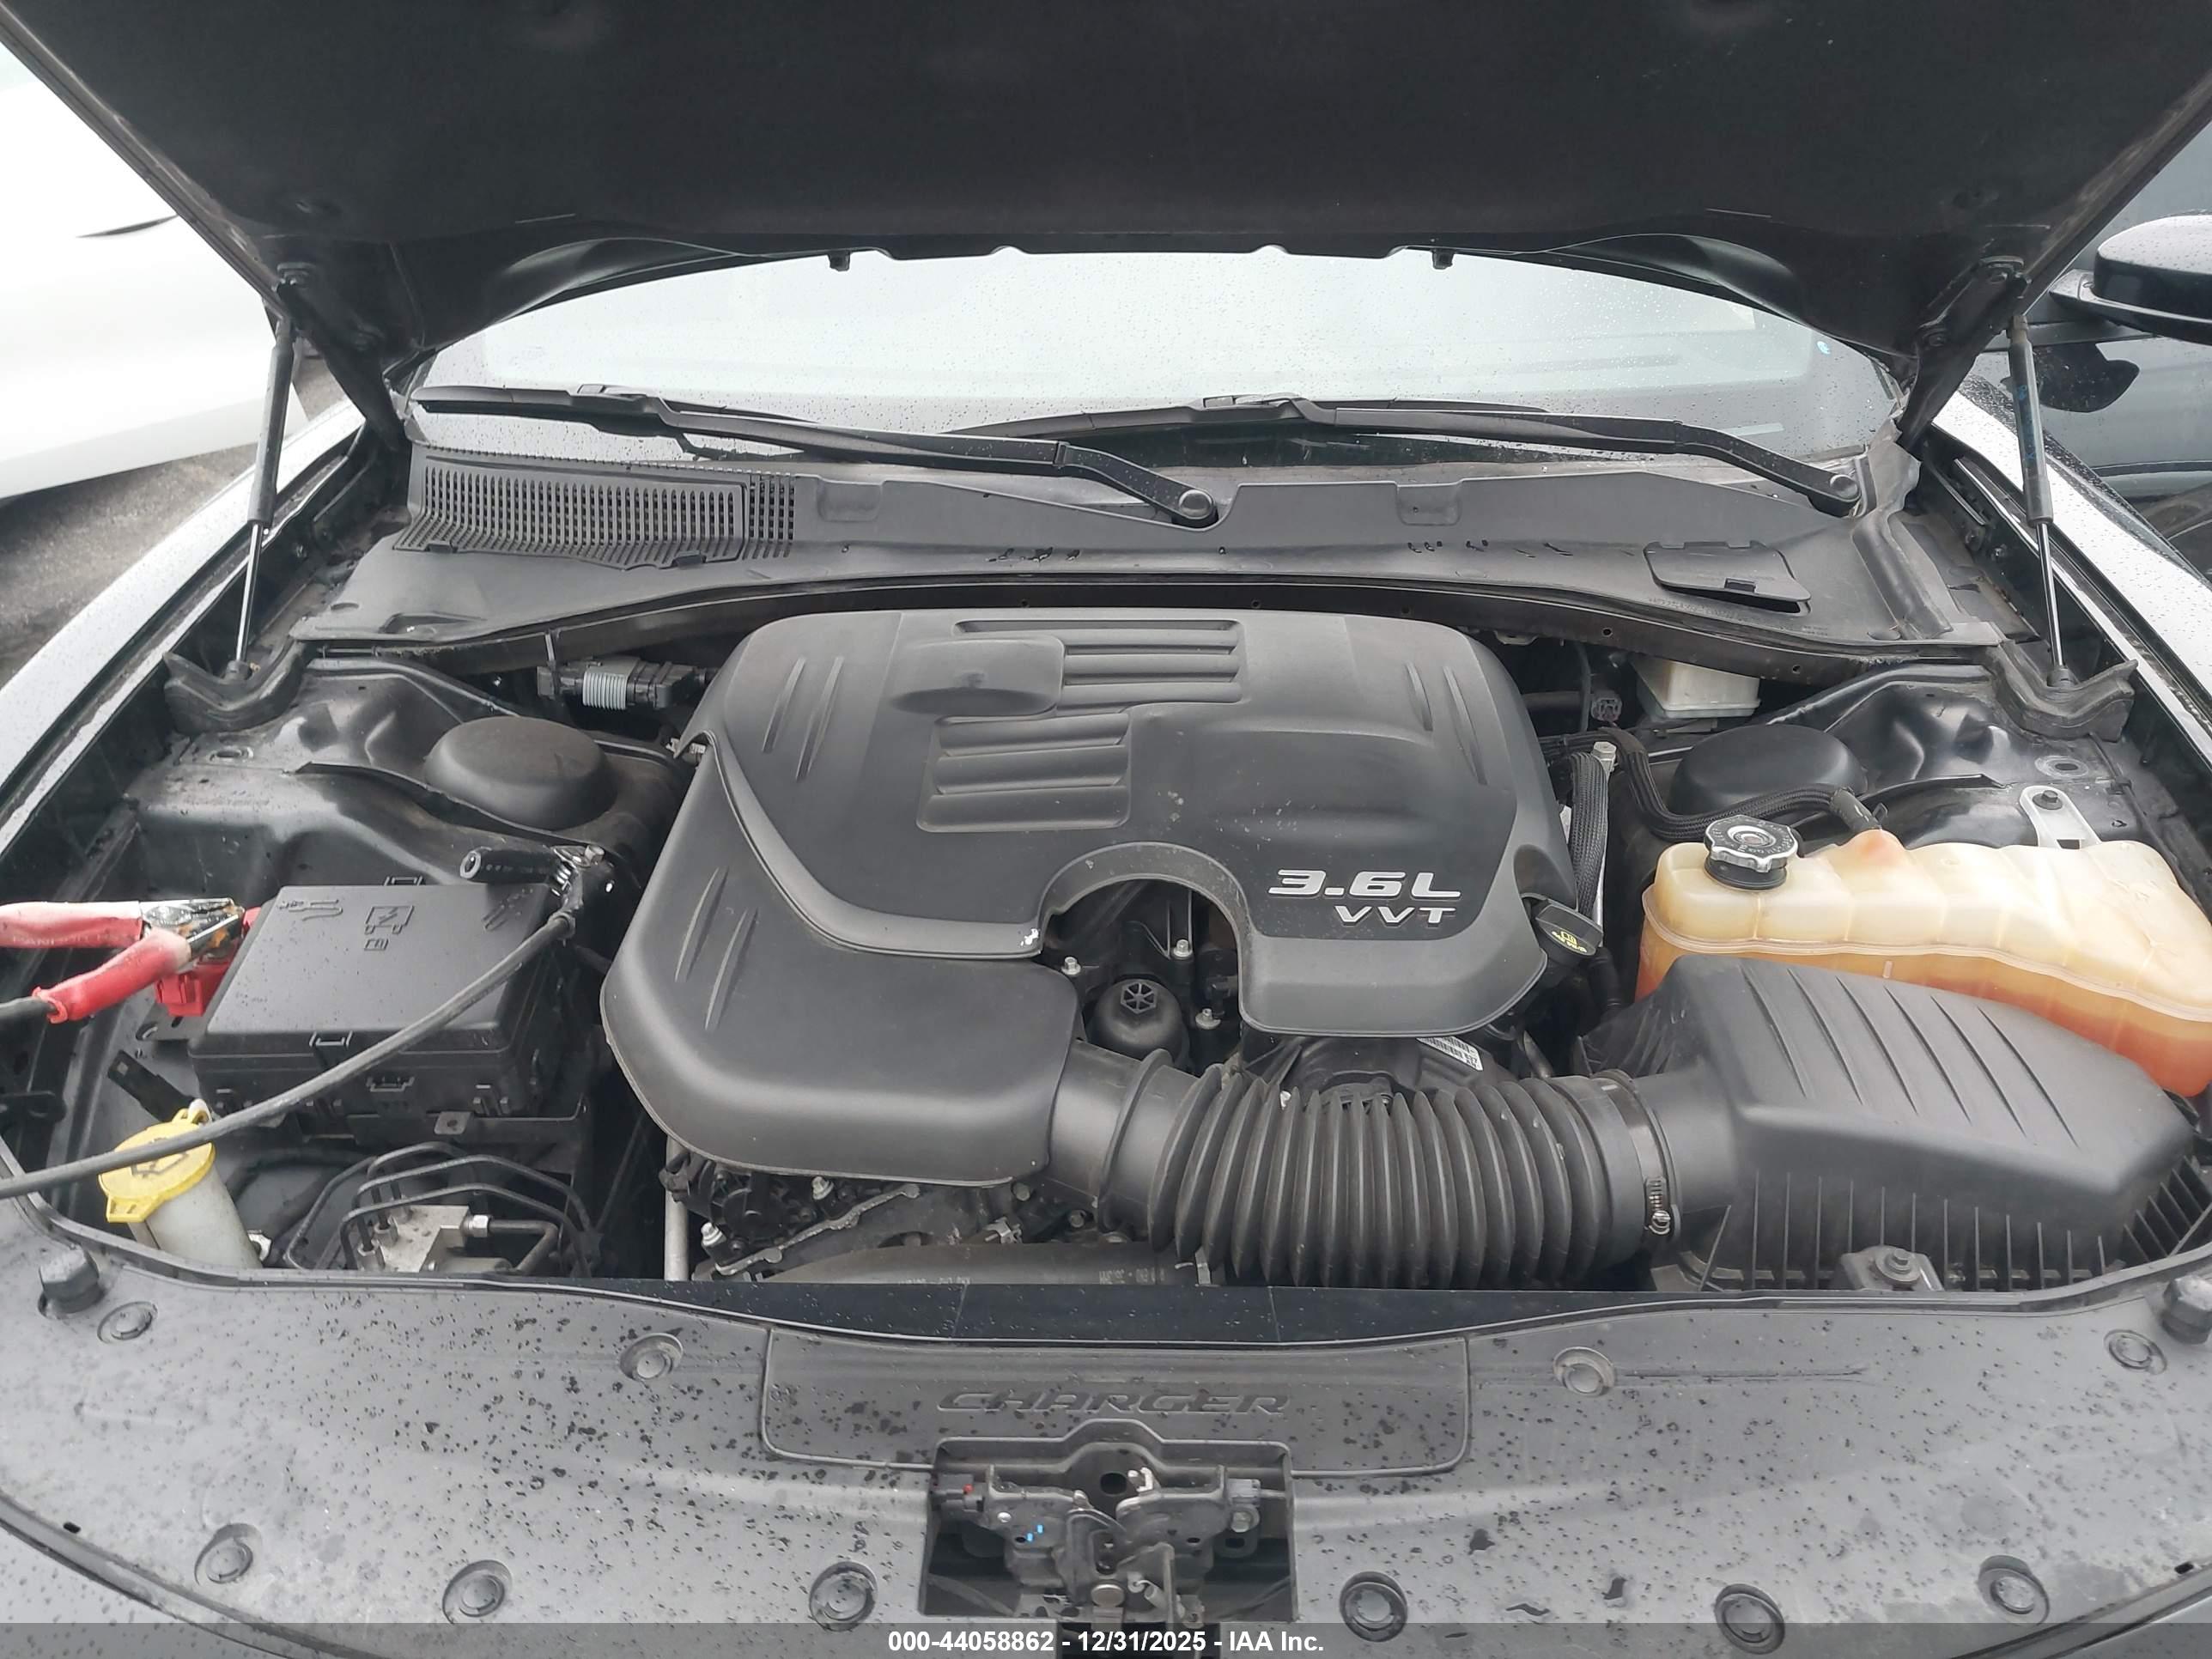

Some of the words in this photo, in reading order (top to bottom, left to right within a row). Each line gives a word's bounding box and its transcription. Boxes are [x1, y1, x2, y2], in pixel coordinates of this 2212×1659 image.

[1267, 869, 1462, 899] 3.6L
[1334, 904, 1457, 926] VVT
[937, 1391, 1290, 1415] CHARGER
